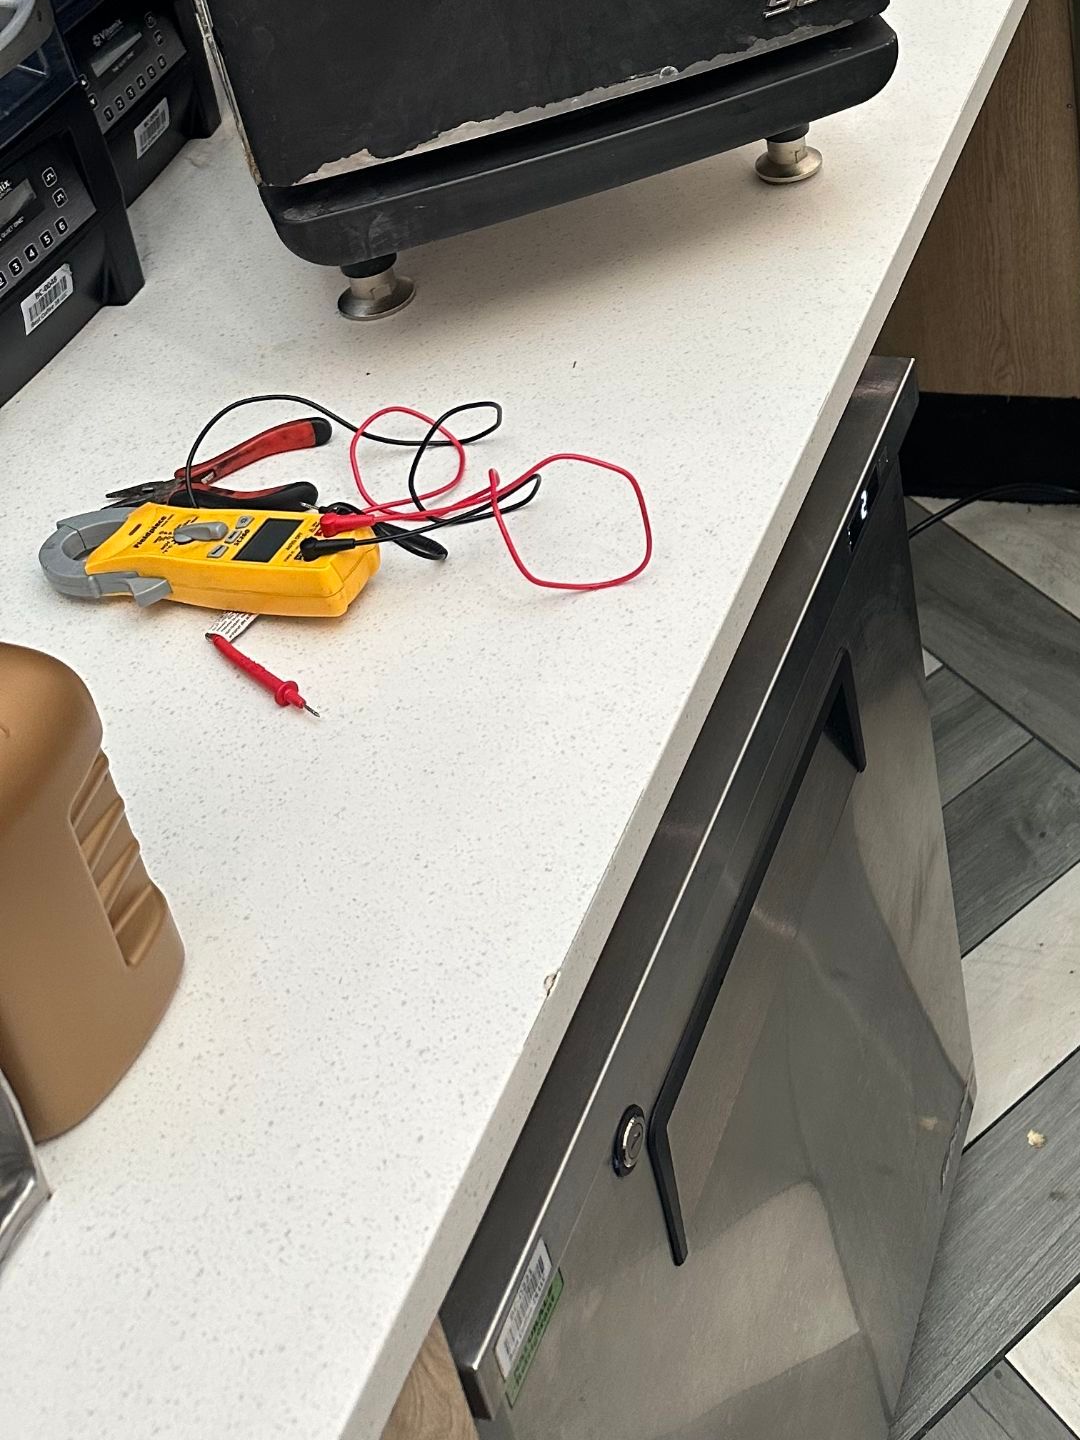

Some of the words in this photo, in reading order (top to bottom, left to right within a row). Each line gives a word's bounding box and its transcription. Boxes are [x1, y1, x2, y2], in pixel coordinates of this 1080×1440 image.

[58, 220, 66, 231] 6
[43, 234, 51, 245] 5
[29, 248, 36, 257] 4
[12, 262, 20, 272] 3
[133, 515, 167, 549] Fieldpiece
